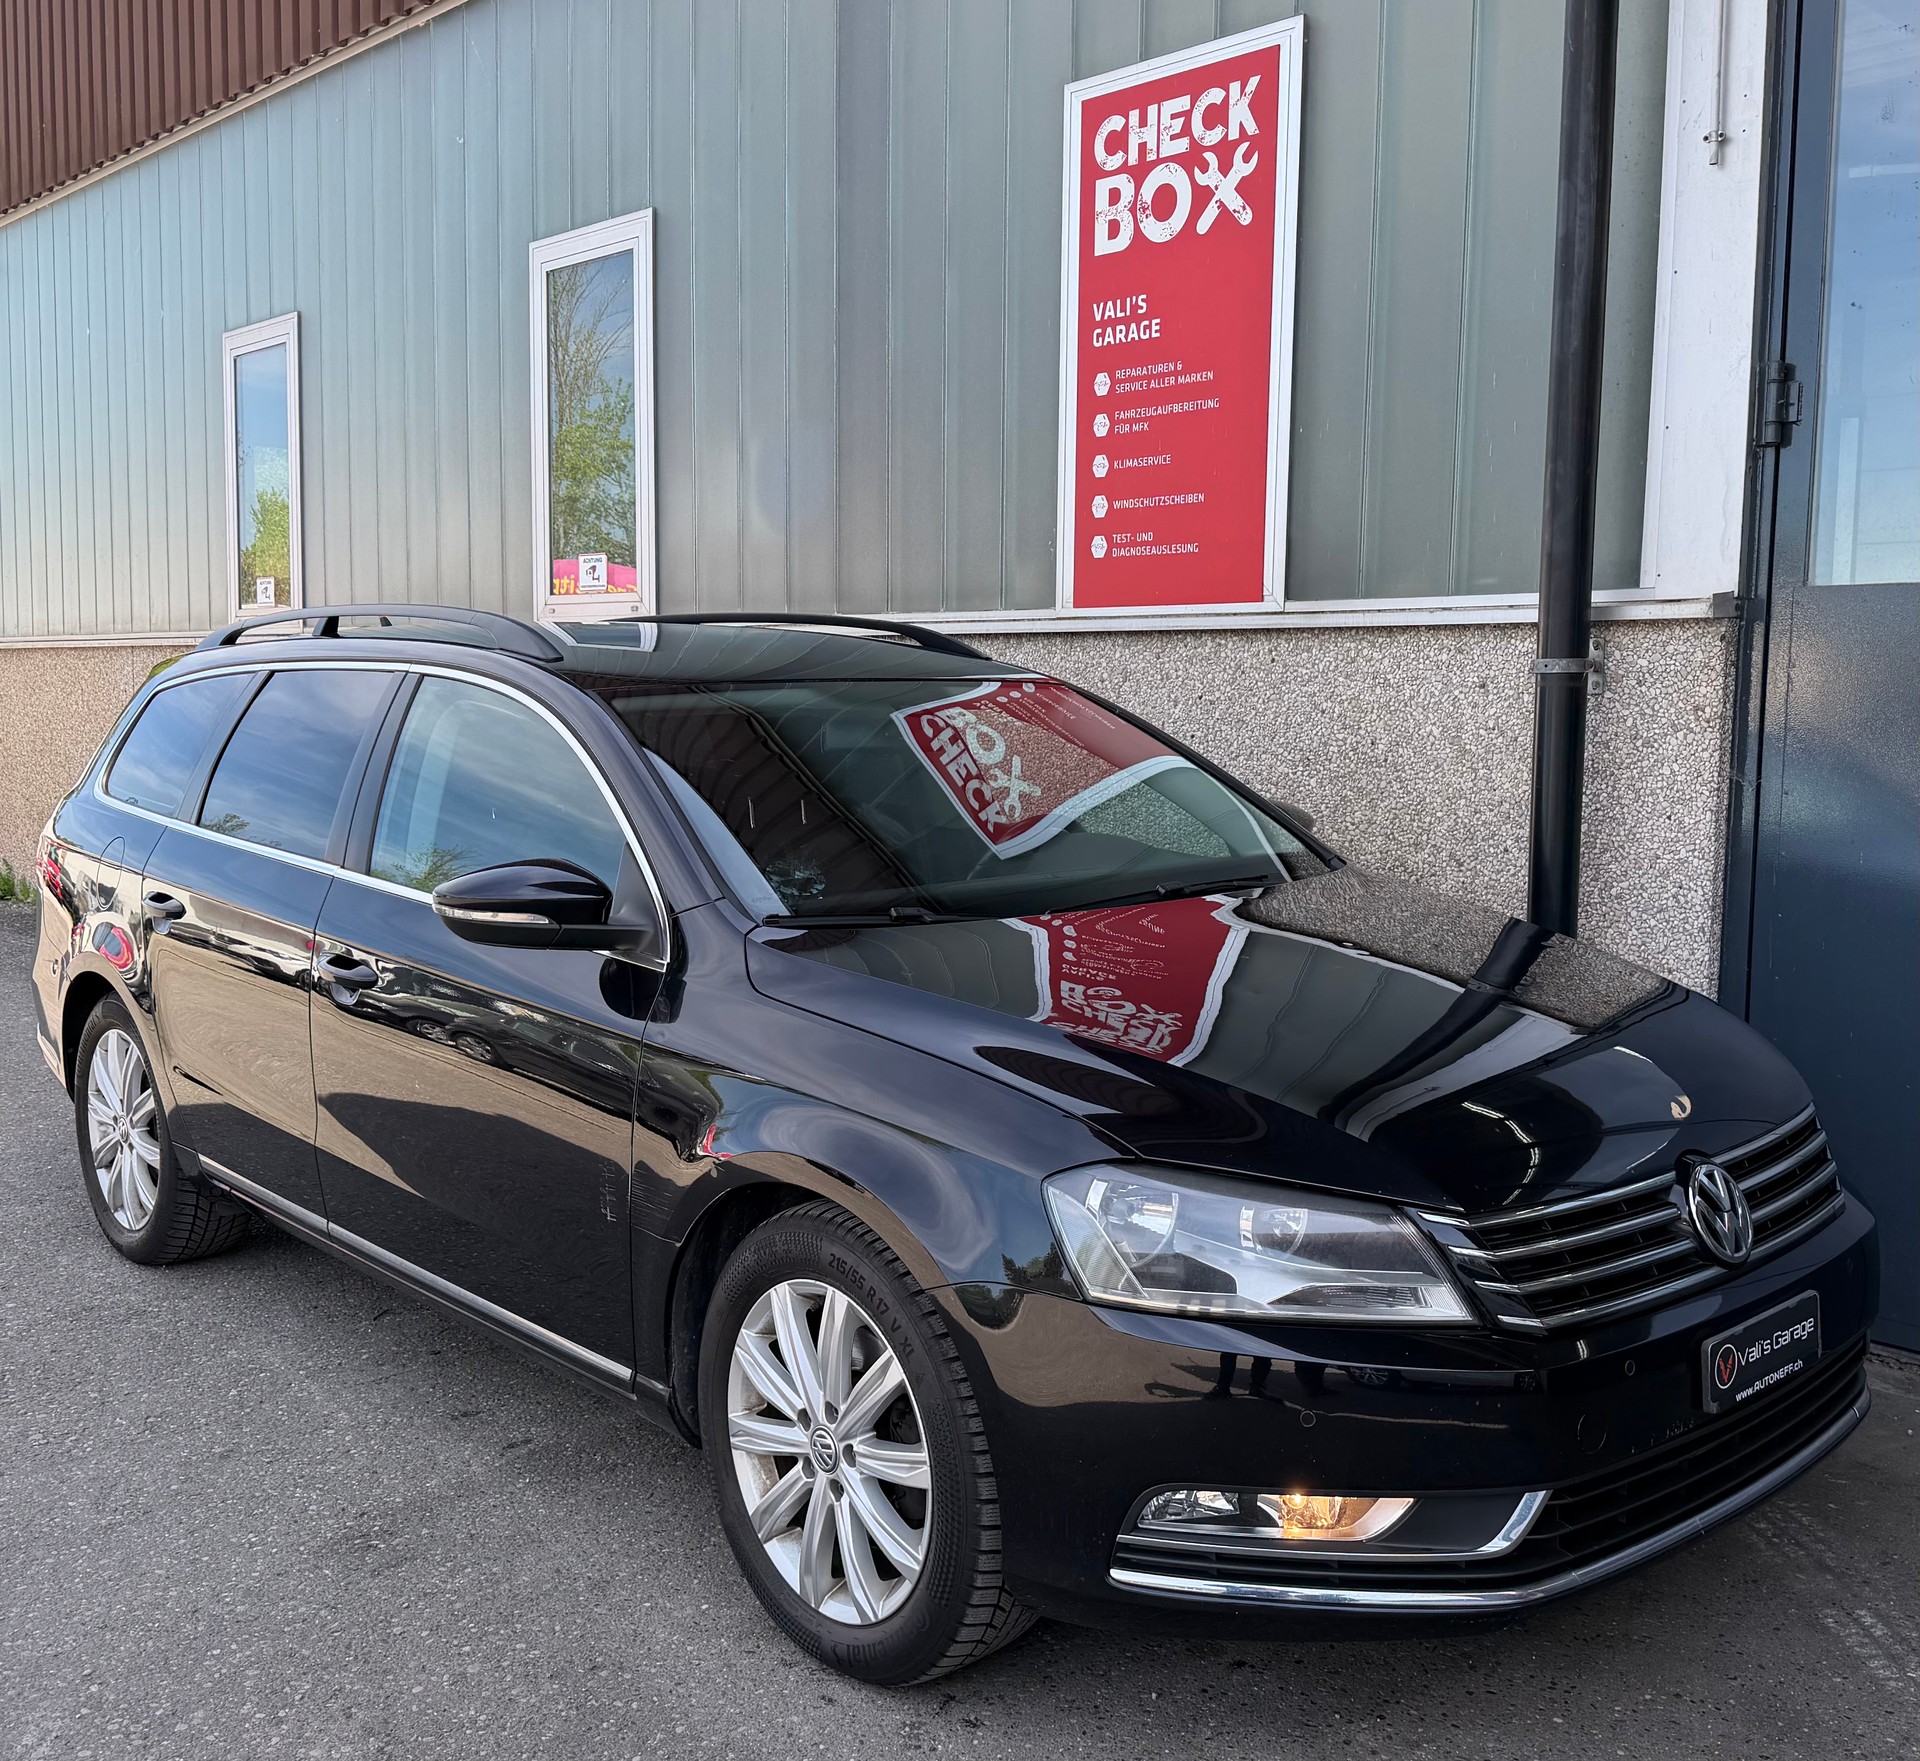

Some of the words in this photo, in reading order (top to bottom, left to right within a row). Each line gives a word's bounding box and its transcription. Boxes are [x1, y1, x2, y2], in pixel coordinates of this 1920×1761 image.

[1094, 75, 1261, 171] CHECK
[1094, 142, 1258, 256] BOX
[1092, 294, 1147, 321] VALI'S
[1092, 318, 1161, 347] GARAGE
[1115, 361, 1175, 380] REPARATUREN
[1177, 360, 1183, 371] &
[1115, 380, 1148, 394] SERVICE
[1150, 376, 1176, 389] ALLER
[1177, 370, 1214, 385] MARKEN
[1114, 398, 1219, 420] FAHRZEUGAUFBEREITUNG
[1114, 422, 1130, 435] FÜR
[1132, 421, 1149, 433] MFK
[1113, 454, 1172, 469] KLIMASERVICE
[1113, 493, 1205, 510] WINDSCHUTZSCHEIBEN
[1112, 533, 1134, 544] TEST-
[1136, 532, 1154, 542] UND
[1112, 543, 1199, 557] DIAGNOSEAUSLESUNG
[828, 1253, 866, 1290] 215/55
[866, 1285, 876, 1302] R
[876, 1298, 890, 1316] 17
[891, 1317, 902, 1334] V
[899, 1336, 915, 1361] XL
[1738, 1339, 1771, 1366] Vali's
[1773, 1318, 1815, 1350] Garage
[1735, 1359, 1804, 1402] www.AUTONEFF.ch
